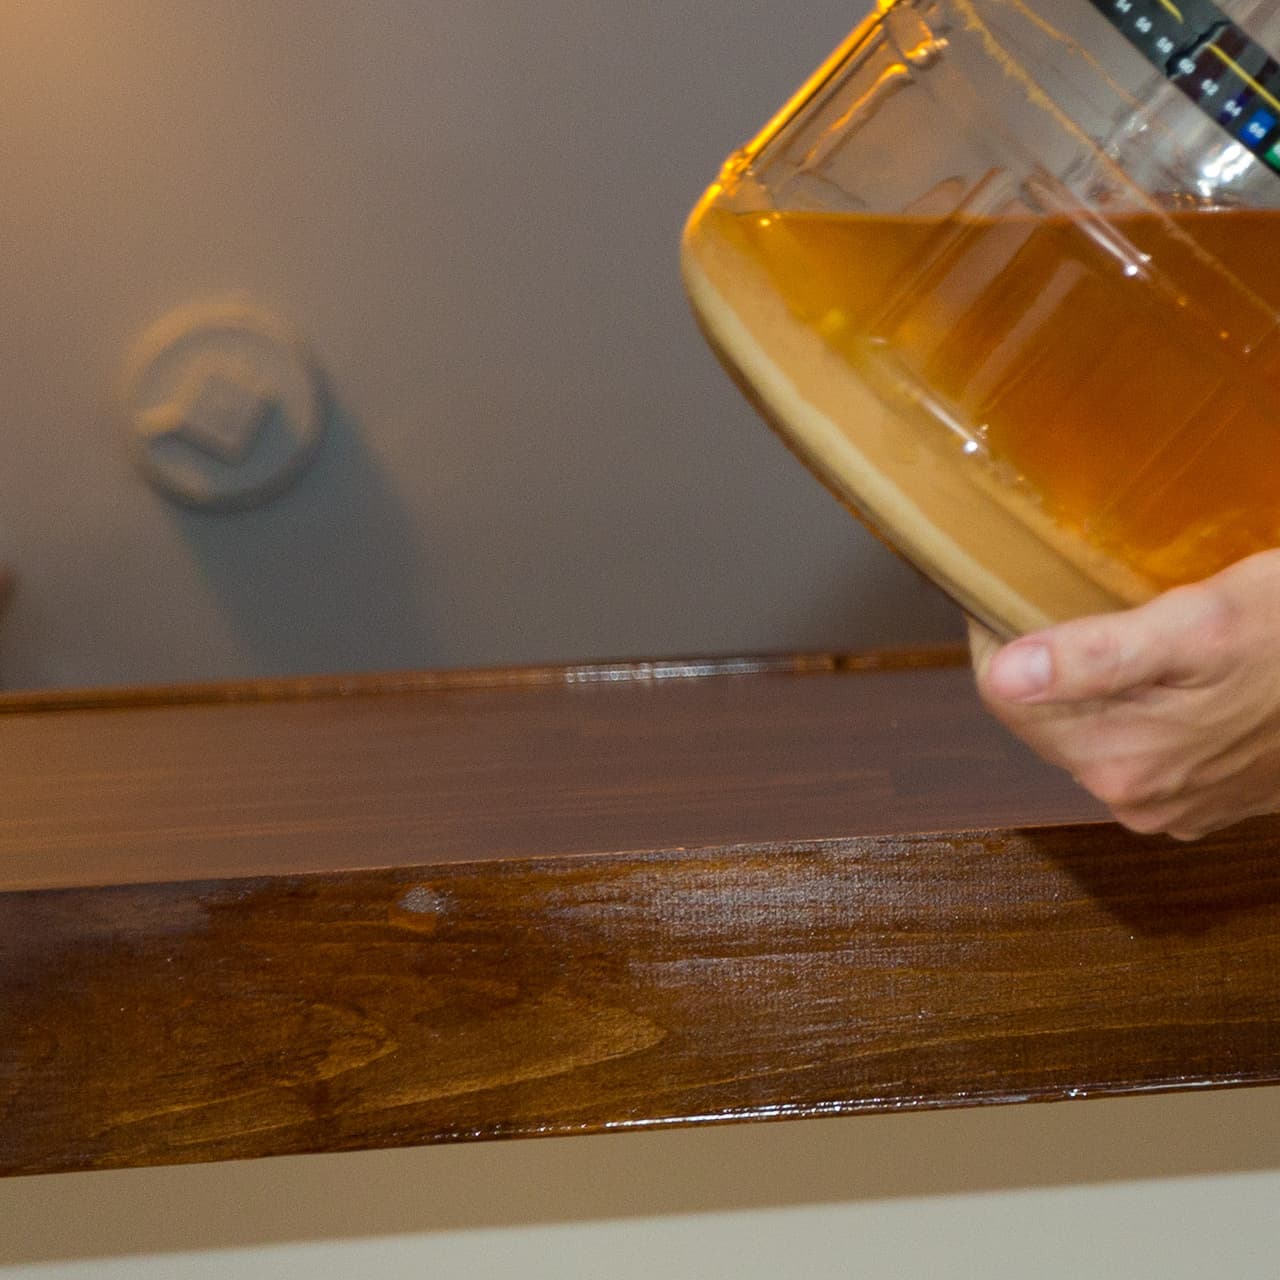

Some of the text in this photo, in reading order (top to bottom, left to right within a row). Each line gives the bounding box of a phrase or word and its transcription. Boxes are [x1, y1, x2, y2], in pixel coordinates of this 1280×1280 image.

[1135, 16, 1153, 33] 56
[1156, 36, 1174, 53] 58
[1201, 79, 1219, 96] 62
[1224, 99, 1243, 117] 64
[1248, 122, 1266, 139] 66
